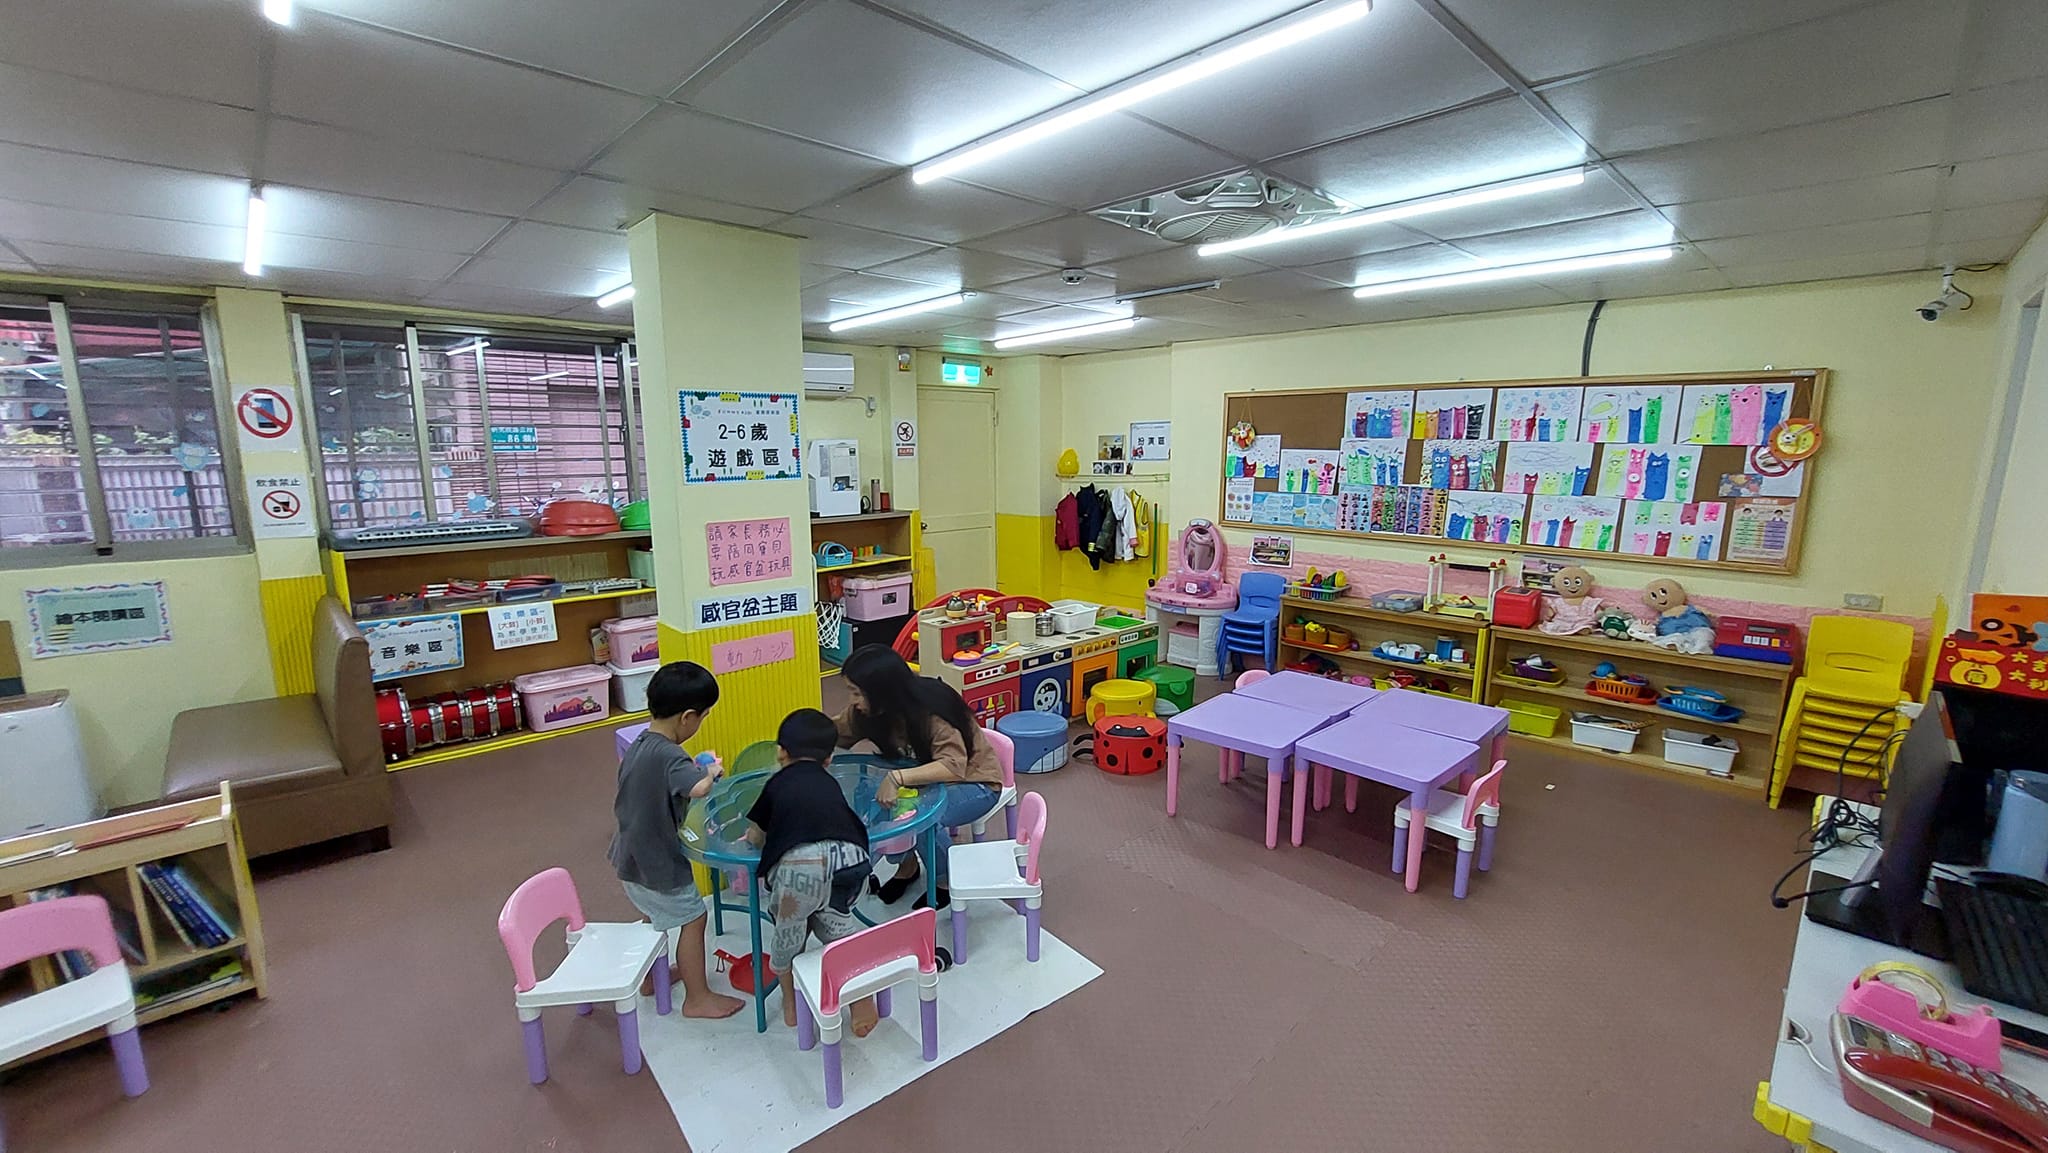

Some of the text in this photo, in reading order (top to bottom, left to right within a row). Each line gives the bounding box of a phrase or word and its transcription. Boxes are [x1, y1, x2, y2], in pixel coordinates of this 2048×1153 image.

[708, 448, 780, 468] 遊戲區
[256, 479, 301, 487] 飲食禁止
[709, 523, 786, 541] 請家長務必
[712, 556, 791, 581] 玩感官盆玩具
[55, 607, 146, 625] 繪本閱讀區
[701, 593, 798, 623] 感官盆主題
[381, 640, 444, 659] 音樂區
[727, 641, 789, 667] 動力沙
